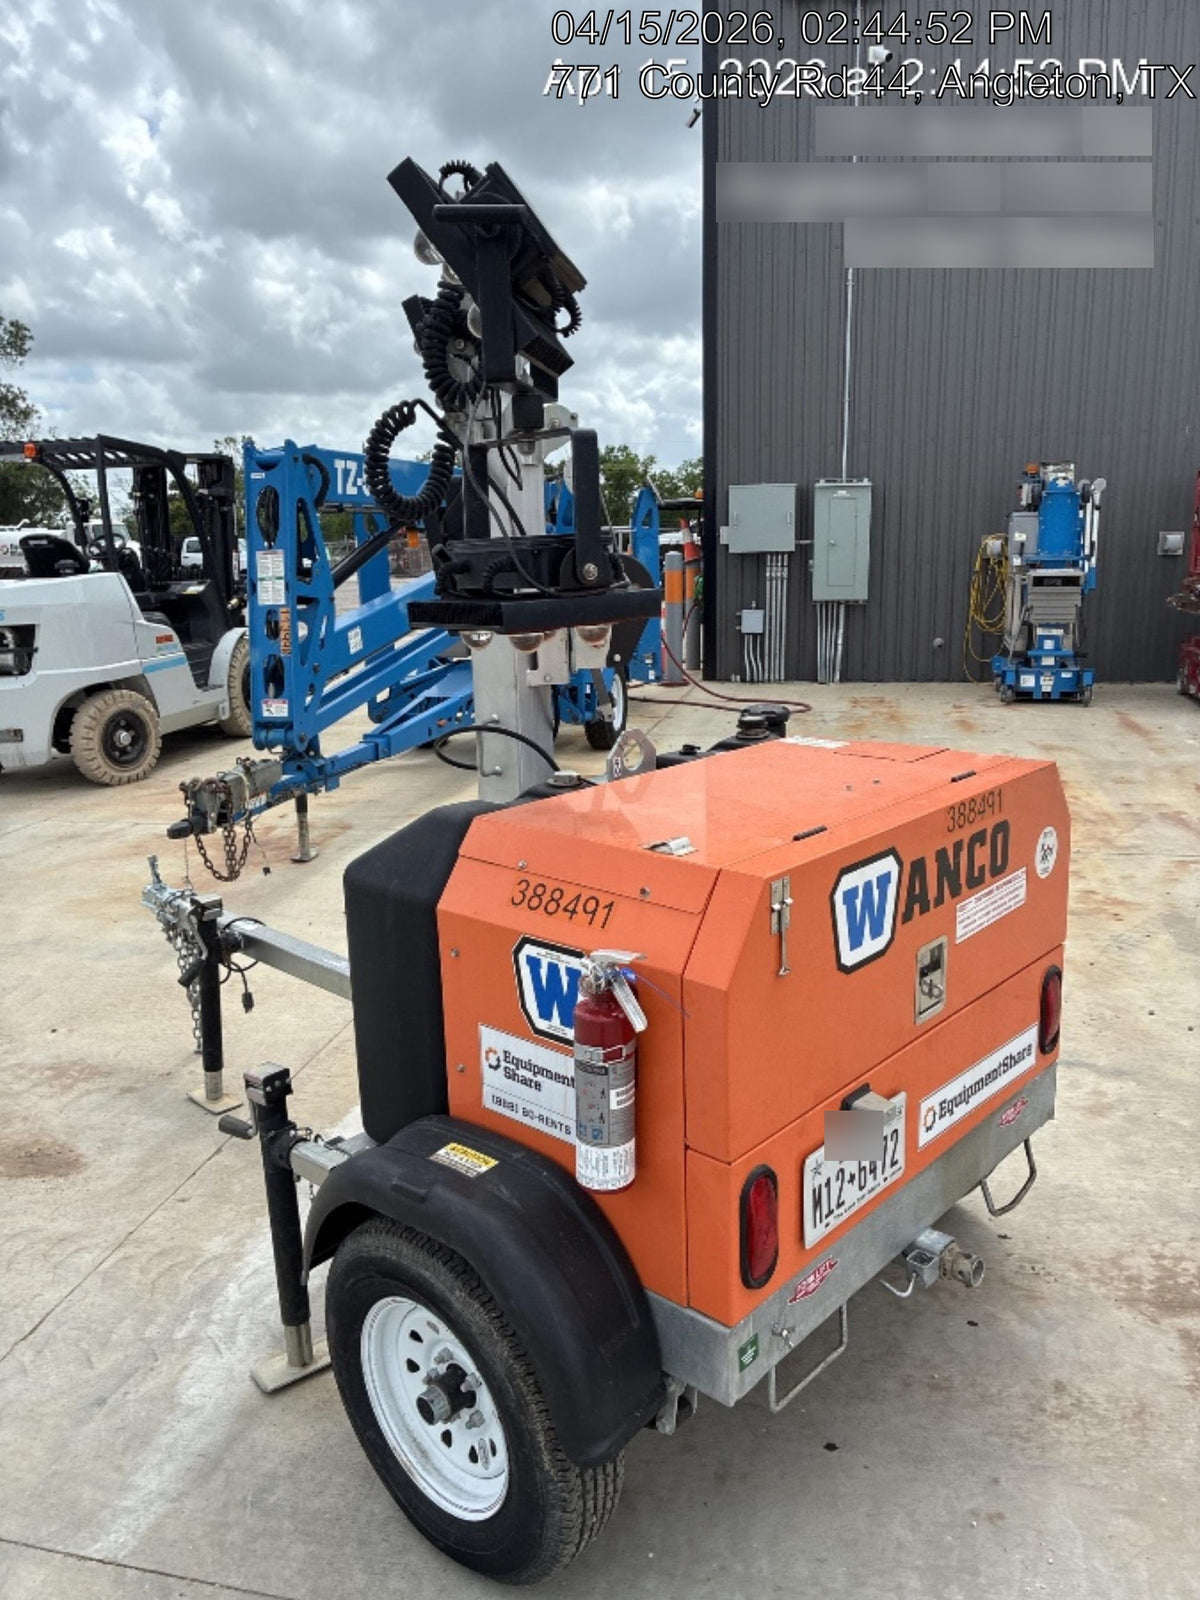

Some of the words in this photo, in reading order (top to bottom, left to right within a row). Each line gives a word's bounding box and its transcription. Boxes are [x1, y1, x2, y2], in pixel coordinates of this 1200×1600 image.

[947, 788, 1003, 833] 388491
[511, 879, 615, 929] 388491
[843, 819, 1010, 952] WANCO
[525, 954, 582, 1030] W
[503, 1050, 575, 1089] Equipment
[503, 1066, 541, 1092] Share
[938, 1043, 1033, 1120] EquipmentShare
